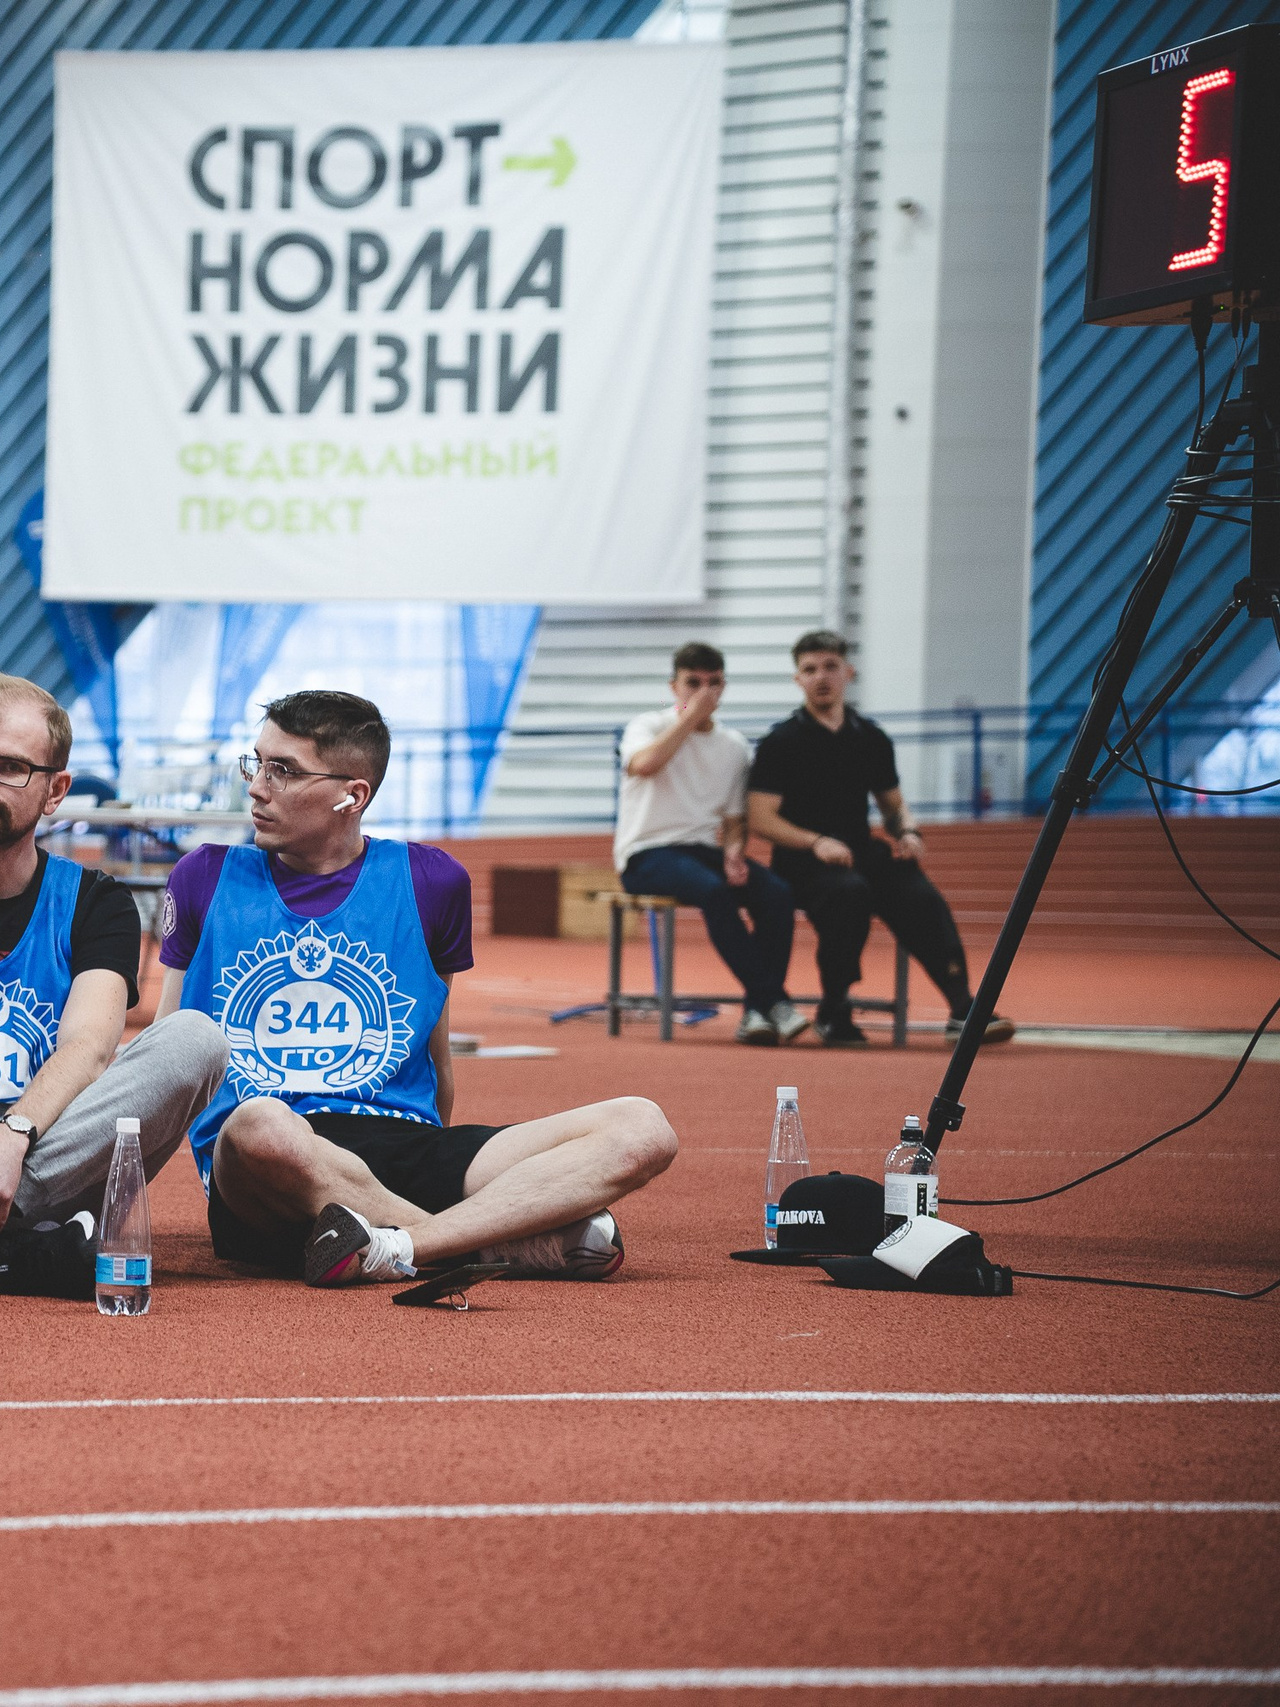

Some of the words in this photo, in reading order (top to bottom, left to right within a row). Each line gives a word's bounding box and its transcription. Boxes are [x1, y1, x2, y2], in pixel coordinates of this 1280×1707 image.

[1150, 46, 1190, 75] LYNX
[188, 121, 502, 211] СПОРТ
[1168, 68, 1235, 271] 5
[187, 226, 567, 313] НОРМА
[184, 331, 562, 415] ЖИЗНИ
[177, 431, 558, 483] ФЕДЕРАЛЬНЫЙ
[178, 496, 366, 534] ПРОЕКТ
[268, 1000, 349, 1034] 344
[280, 1048, 335, 1067] ГТО
